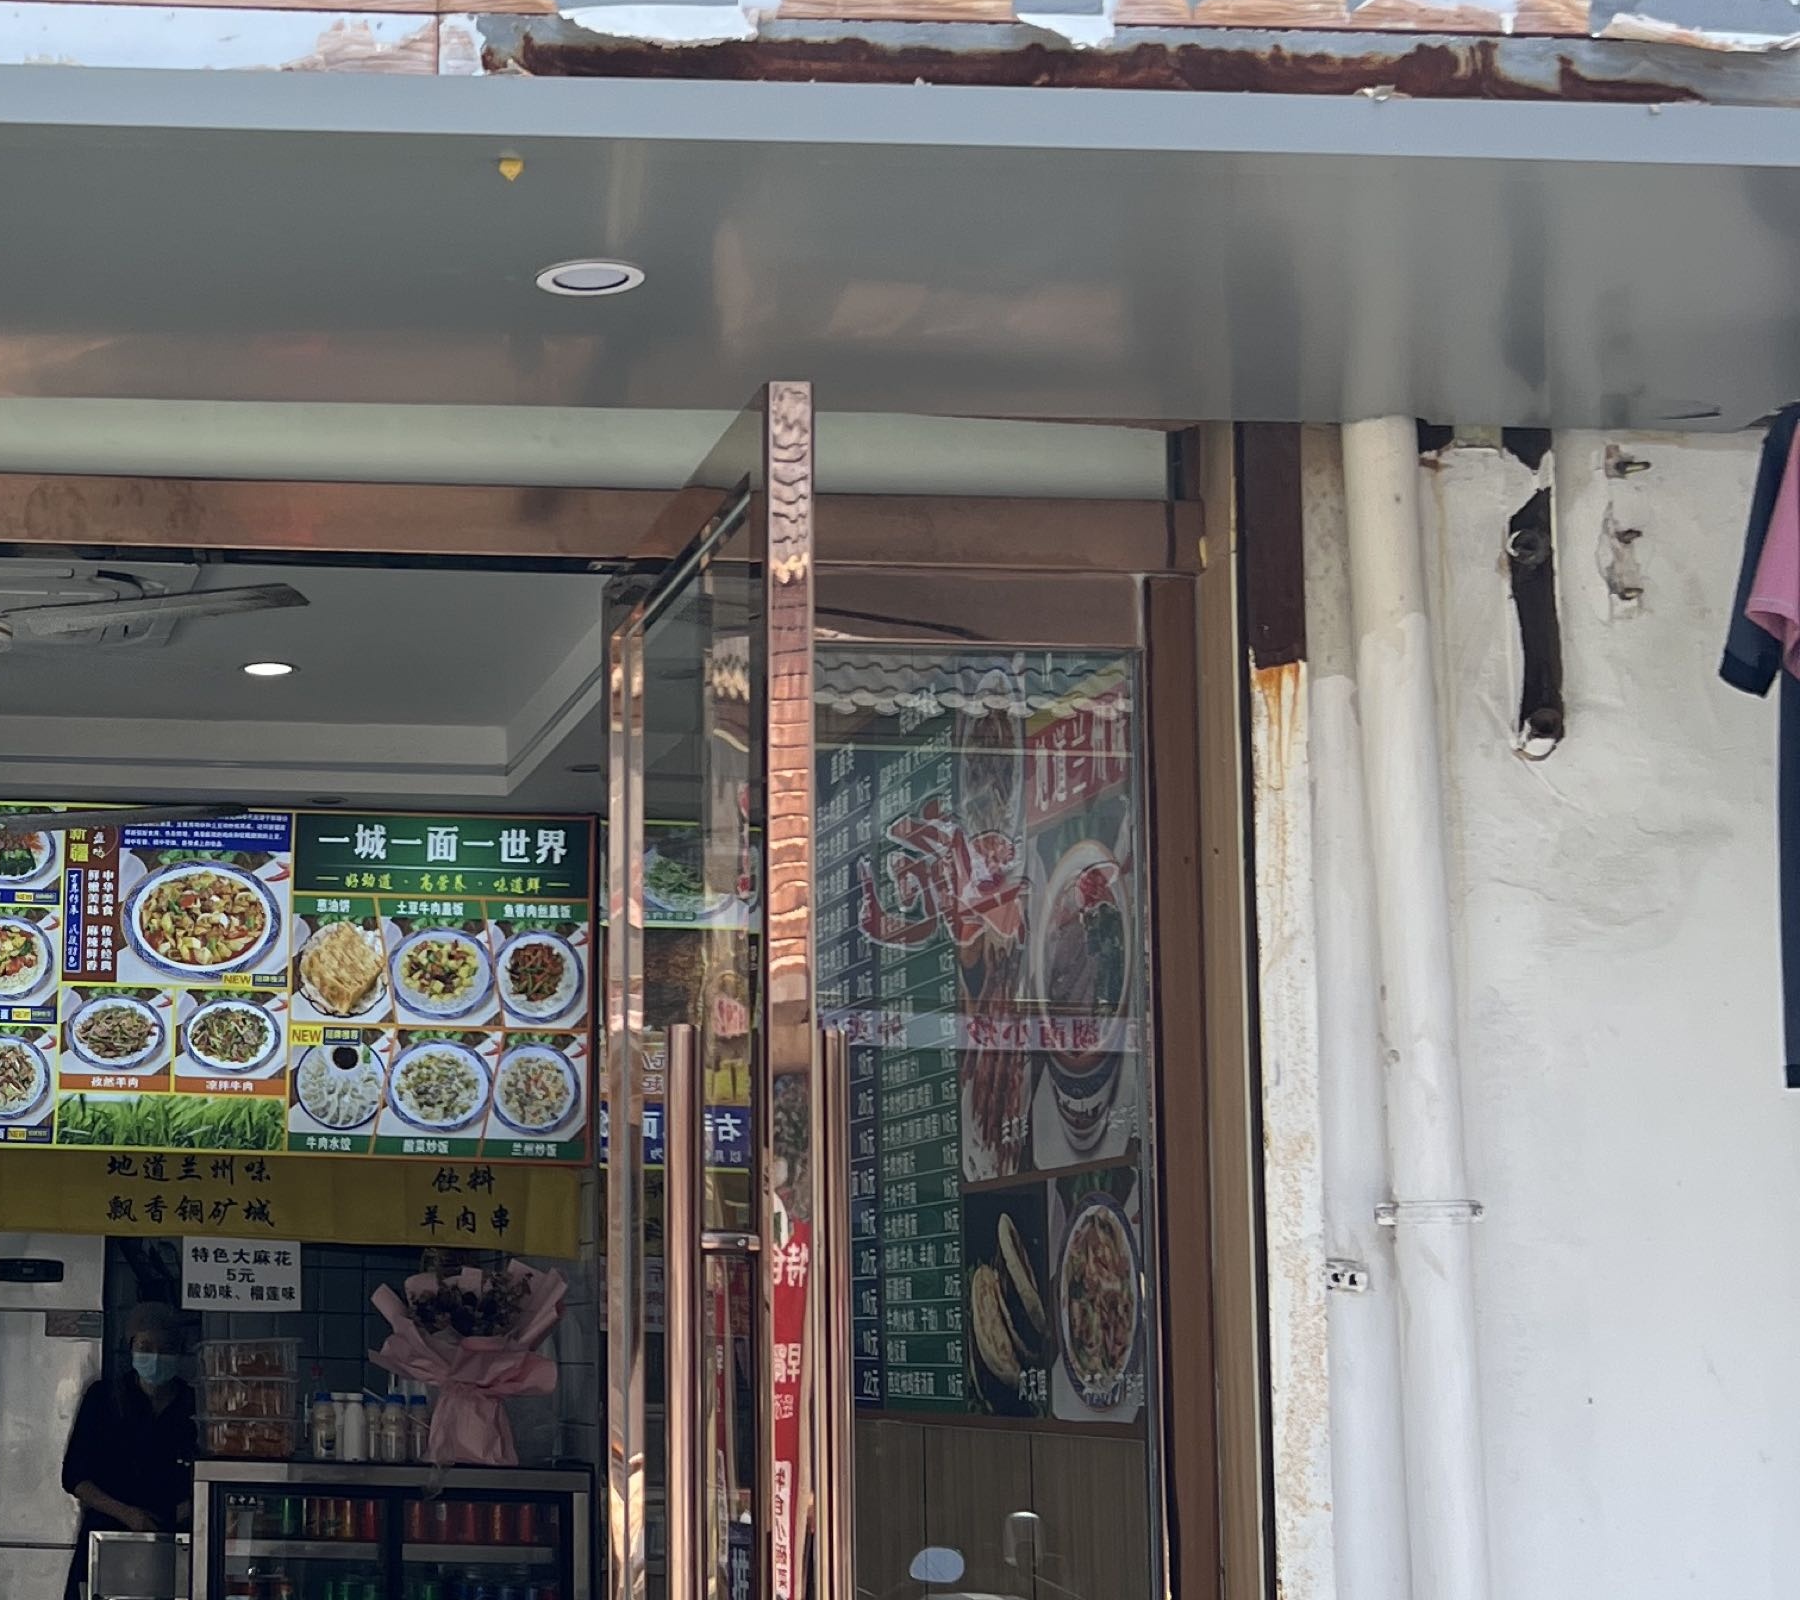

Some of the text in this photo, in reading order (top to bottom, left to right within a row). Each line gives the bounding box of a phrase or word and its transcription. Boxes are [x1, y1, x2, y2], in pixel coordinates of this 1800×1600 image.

[318, 823, 567, 864] 一城一面一世界
[292, 1029, 322, 1043] NEW
[106, 1153, 272, 1186] 地道兰州味
[432, 1165, 496, 1196] 饮料
[419, 1204, 510, 1237] 羊肉串
[191, 1246, 293, 1266] 特色大麻花
[226, 1268, 256, 1283] 5元
